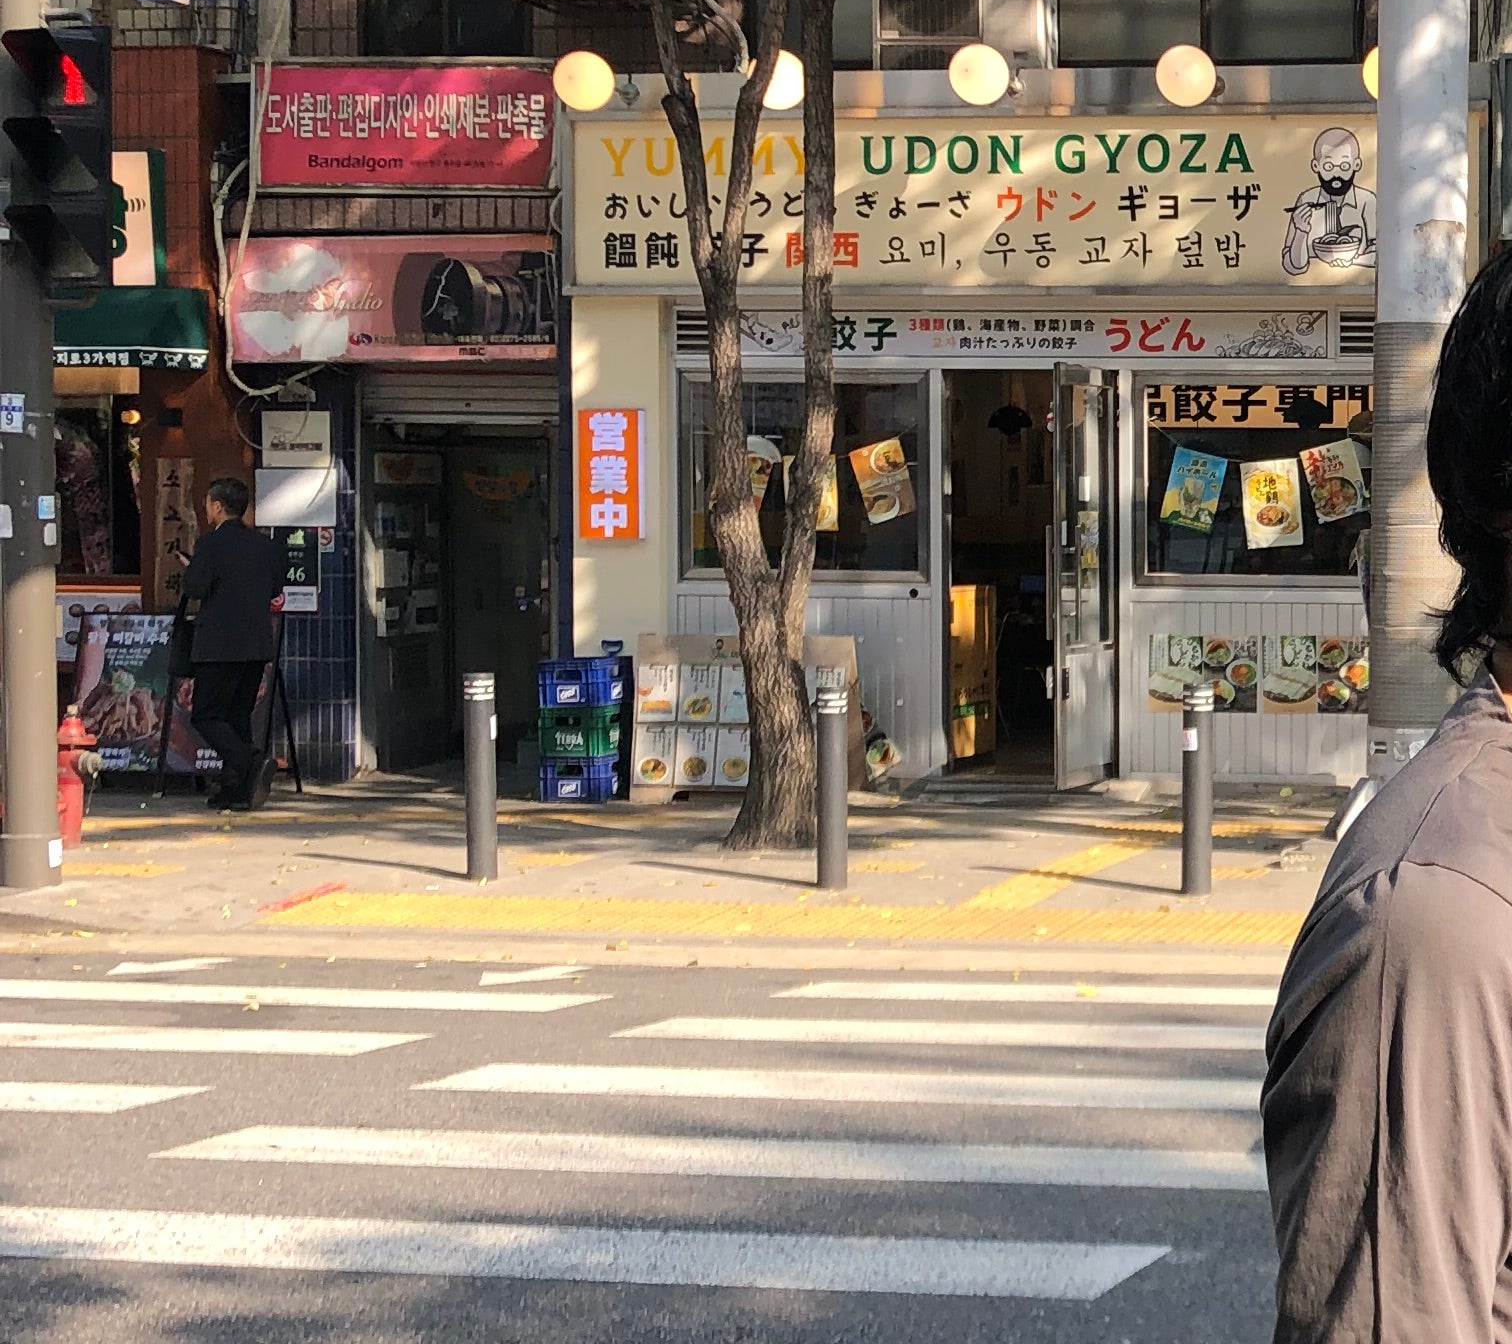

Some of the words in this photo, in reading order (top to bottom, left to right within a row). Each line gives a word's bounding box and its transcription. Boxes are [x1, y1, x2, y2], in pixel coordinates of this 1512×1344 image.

[307, 153, 404, 173] Bandalgom
[860, 133, 1025, 176] UDON
[1054, 132, 1255, 175] GYOZA
[854, 189, 973, 220] ぎょーざ
[996, 186, 1097, 223] ウドン
[1117, 183, 1262, 223] ギョーザ
[982, 231, 1057, 270] 우동
[1077, 231, 1154, 270] 교자
[1174, 230, 1248, 270] 덮밥
[1104, 315, 1206, 354] うどん
[52, 351, 130, 366] 지로3가역점
[588, 410, 630, 538] 営業中
[286, 566, 306, 583] 46
